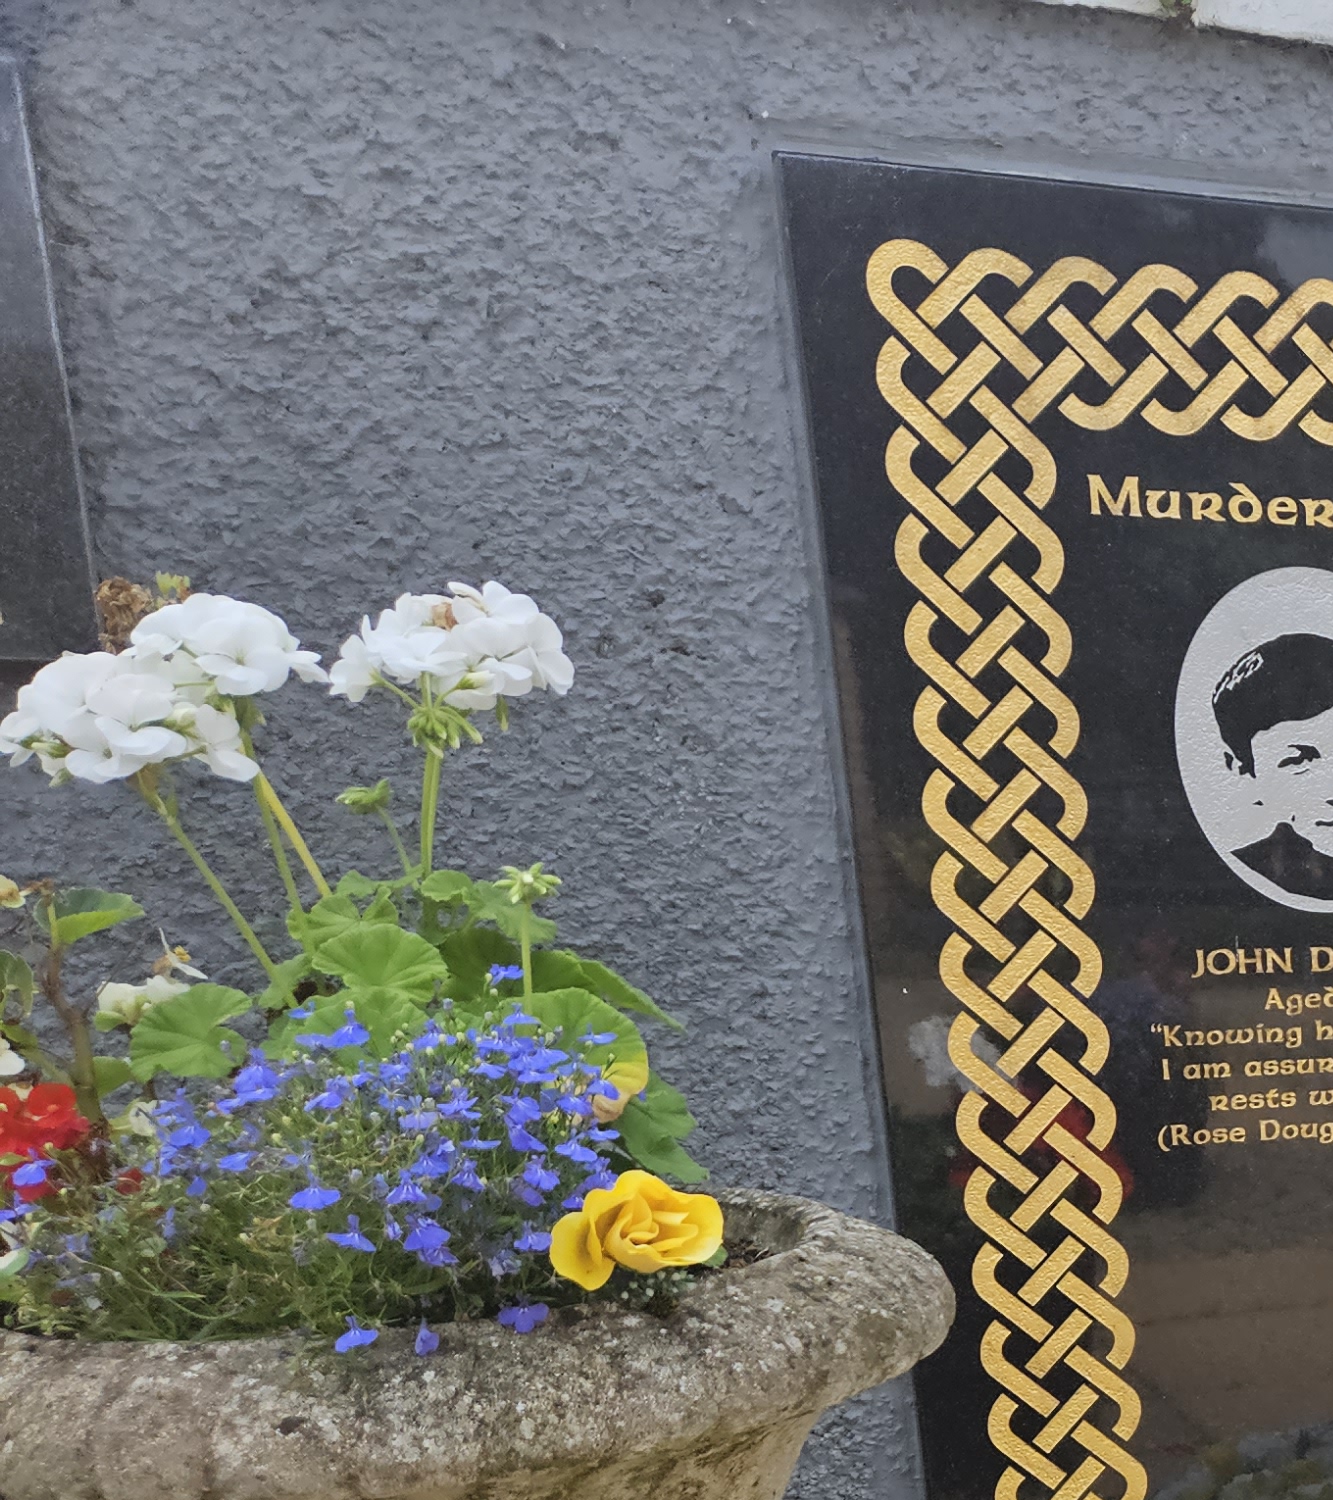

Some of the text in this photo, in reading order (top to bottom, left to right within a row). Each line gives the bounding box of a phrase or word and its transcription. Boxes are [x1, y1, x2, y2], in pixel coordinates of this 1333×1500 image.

[1191, 947, 1294, 979] JOHN
[1161, 1058, 1171, 1081] I
[1183, 1061, 1233, 1080] am
[1209, 1088, 1297, 1112] rests
[1157, 1123, 1248, 1152] (Rose
